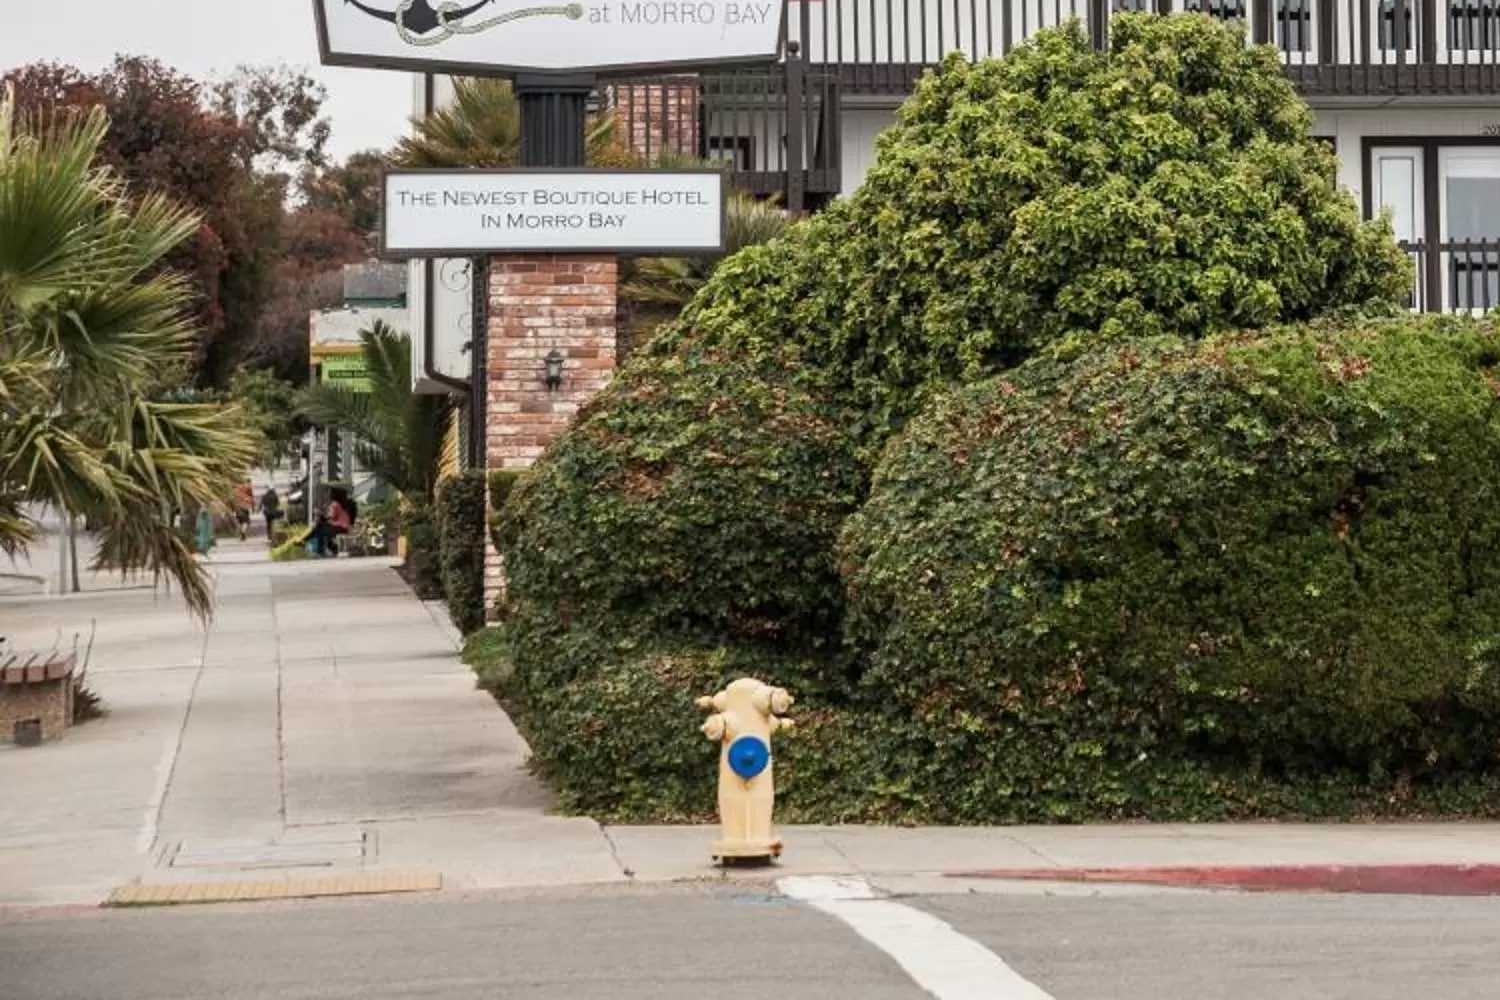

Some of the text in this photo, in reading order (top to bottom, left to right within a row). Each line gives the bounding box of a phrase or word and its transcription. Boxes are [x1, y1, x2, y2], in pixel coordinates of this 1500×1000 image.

[588, 1, 772, 25] at MORRO BAY
[396, 189, 709, 207] THE NEWEST BOUTIQUE HOTEL
[481, 212, 627, 229] IN MORRO BAY
